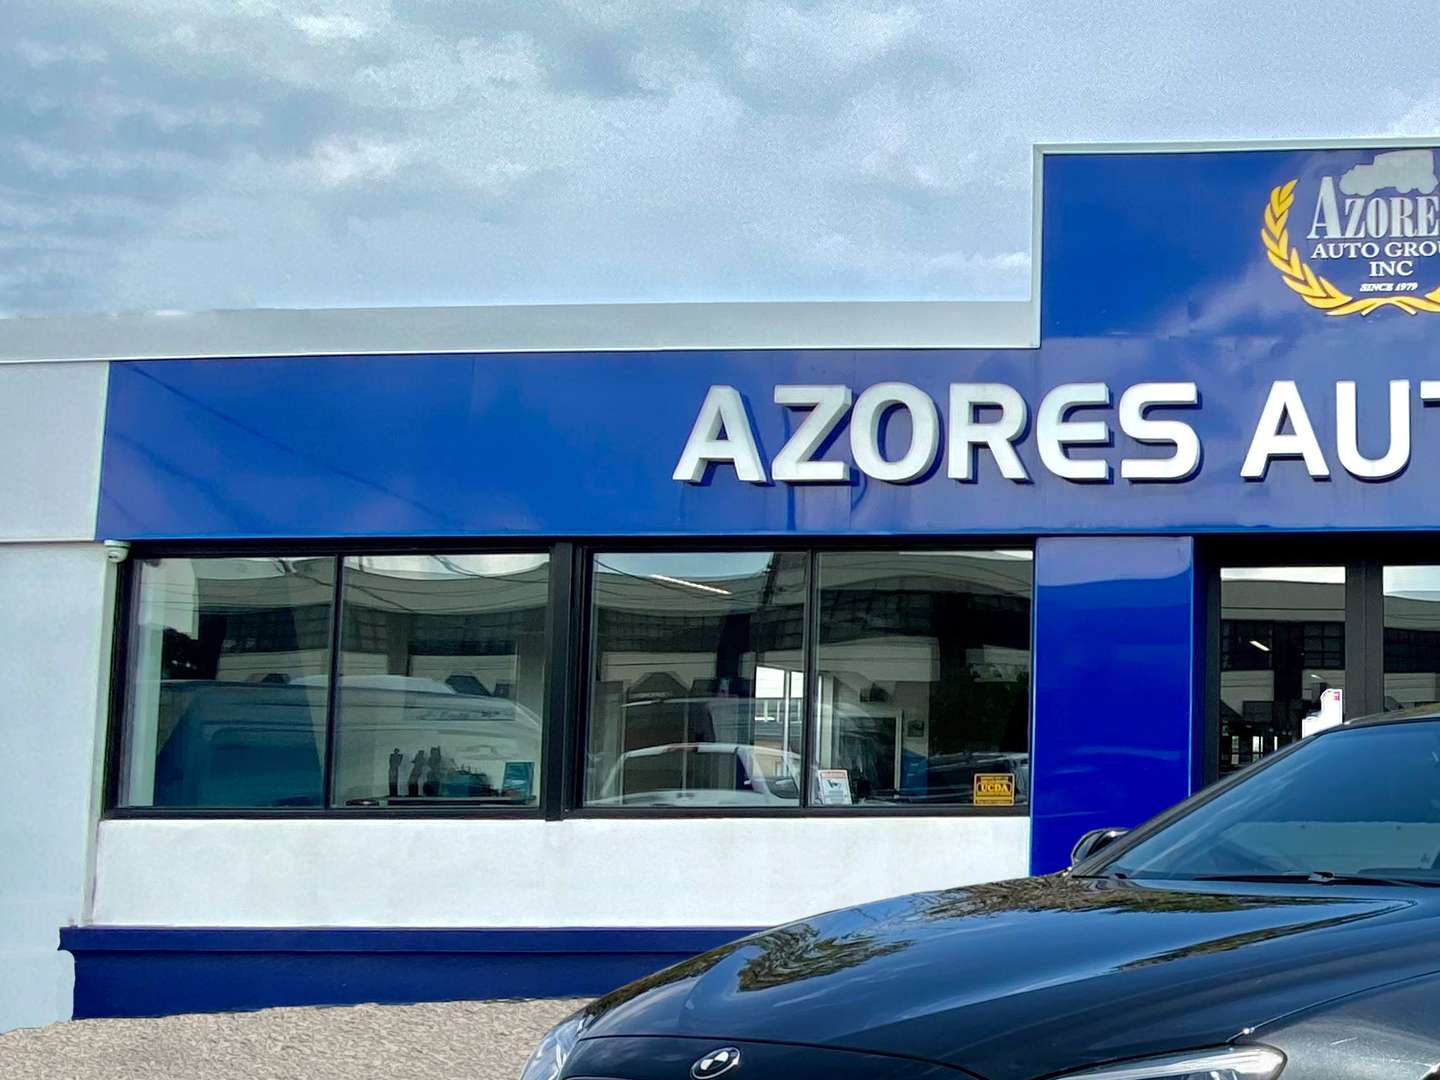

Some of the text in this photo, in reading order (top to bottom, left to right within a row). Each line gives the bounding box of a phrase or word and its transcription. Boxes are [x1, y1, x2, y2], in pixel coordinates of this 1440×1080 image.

[1310, 241, 1380, 259] AUTO
[1369, 260, 1414, 277] INC
[1395, 281, 1418, 292] 1979
[671, 381, 1203, 485] AZORES
[981, 784, 1009, 792] UCDA
